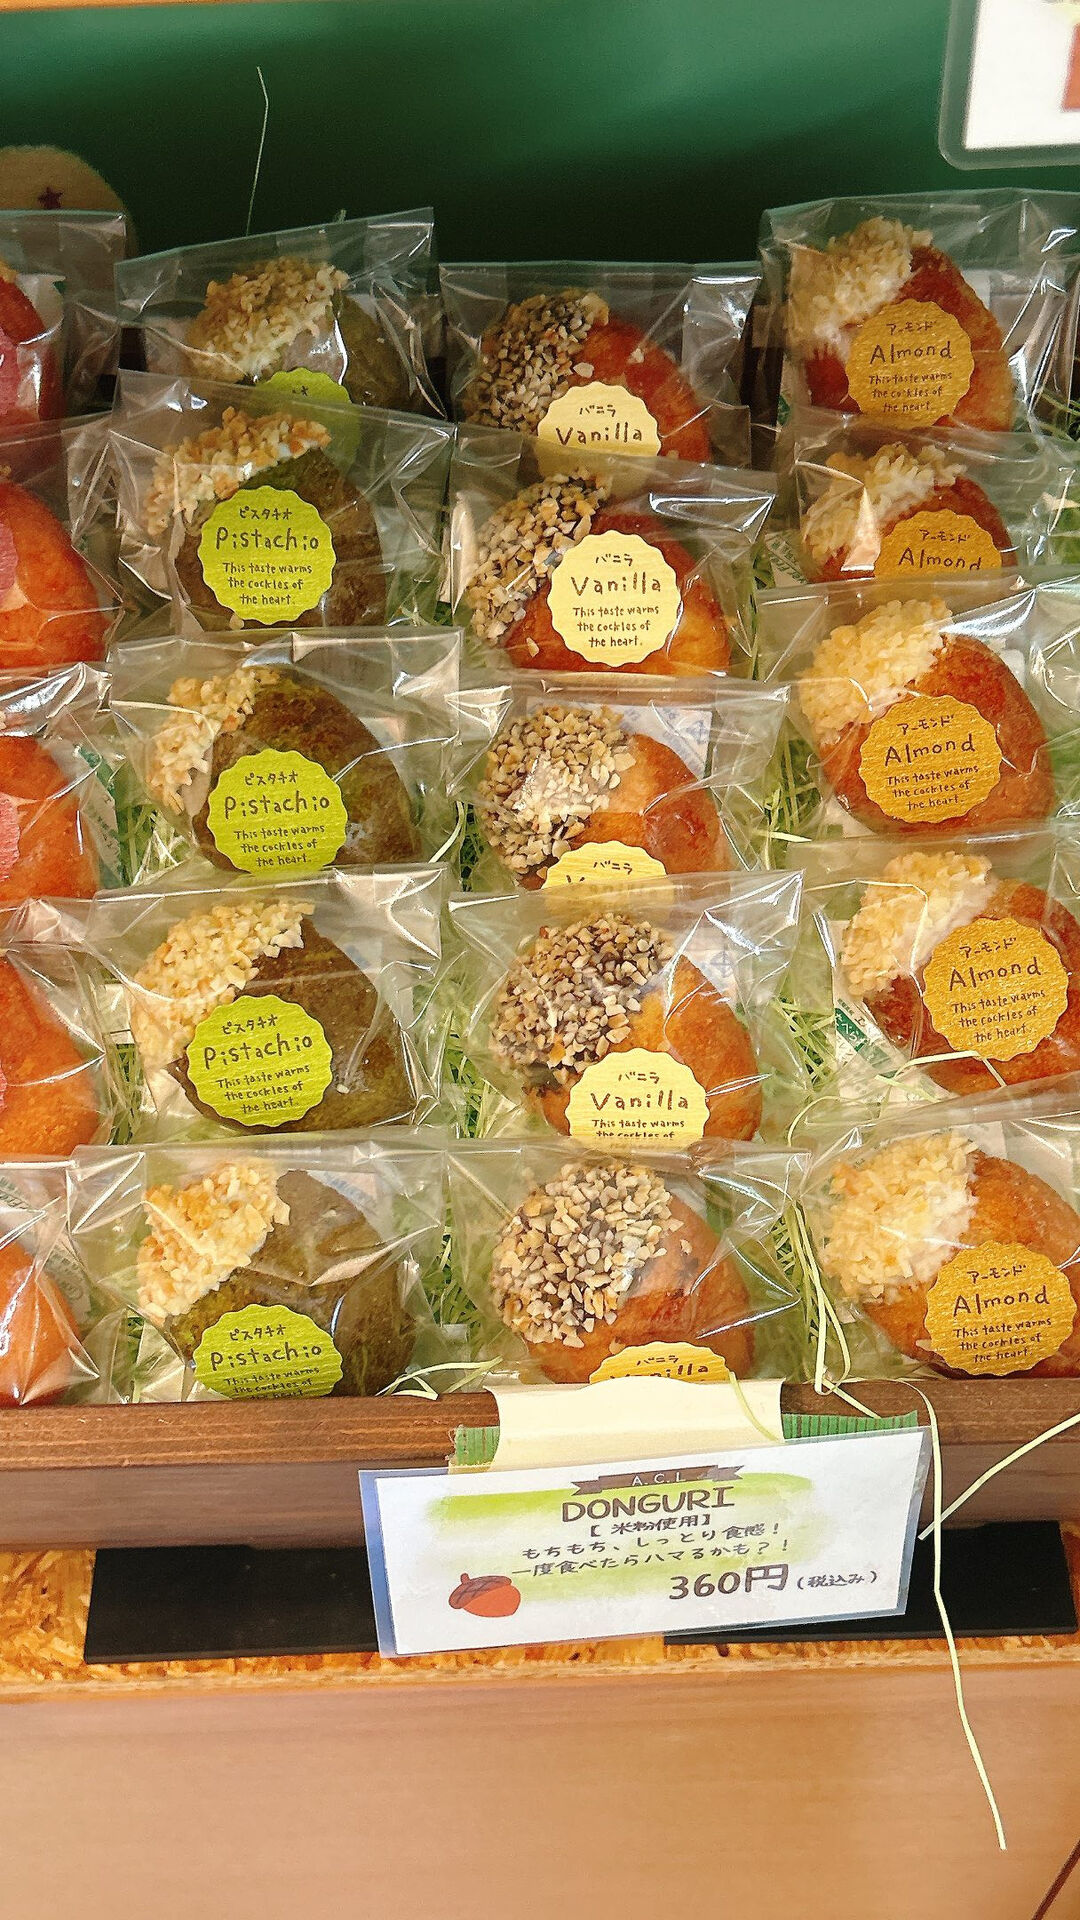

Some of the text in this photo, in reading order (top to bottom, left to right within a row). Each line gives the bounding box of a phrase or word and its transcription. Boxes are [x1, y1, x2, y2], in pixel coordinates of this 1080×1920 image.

[870, 341, 952, 364] Almond
[580, 405, 616, 417] バニラ
[556, 422, 642, 445] Vanilla
[239, 506, 292, 520] ピスタキオ
[216, 527, 319, 550] Pistachio
[919, 529, 970, 543] アーモンド
[596, 554, 633, 566] バニラ
[898, 547, 981, 570] Almond
[223, 563, 312, 574] This taste warms
[228, 577, 304, 590] the cockles of
[571, 572, 661, 596] Vanilla
[240, 594, 257, 604] the
[573, 606, 659, 617] This taste warms
[577, 620, 651, 631] the cockles of
[589, 637, 606, 647] the
[897, 714, 954, 735] アーモンド
[885, 733, 975, 766] Almond
[245, 770, 298, 785] ピスタキオ
[888, 765, 979, 785] This taste warms
[892, 780, 970, 797] the cockles of
[225, 790, 330, 819] Pistachio
[908, 801, 924, 811] the
[234, 825, 325, 840] This taste warms
[241, 839, 318, 853] the cockles of
[256, 857, 274, 867] the
[594, 860, 632, 875] バニラ
[959, 937, 1017, 958] アーモンド
[950, 957, 1041, 991] Almond
[952, 990, 1046, 1014] This taste warms
[222, 1015, 278, 1034] ピスタキオ
[959, 1006, 1038, 1027] the cockles of
[974, 1033, 992, 1043] the
[204, 1033, 312, 1070] Pistachio
[216, 1065, 310, 1089] This taste warms
[618, 1072, 659, 1084] バニラ
[224, 1081, 303, 1101] the cockles of
[591, 1090, 688, 1110] Vanilla
[241, 1104, 260, 1114] the
[592, 1119, 615, 1128] This
[619, 1119, 647, 1128] taste
[967, 1265, 1027, 1284] アーモンド
[953, 1285, 1049, 1316] Almond
[230, 1324, 286, 1341] ピスタキオ
[953, 1318, 1052, 1338] This taste warms
[960, 1333, 1041, 1350] the cockles of
[211, 1342, 322, 1371] Pistachio
[637, 1355, 679, 1366] バニラ
[974, 1354, 991, 1362] the
[610, 1364, 708, 1378] illa
[562, 1486, 735, 1522] DONGURI
[591, 1514, 710, 1537] 【米粉使用】
[669, 1563, 789, 1600] 360円
